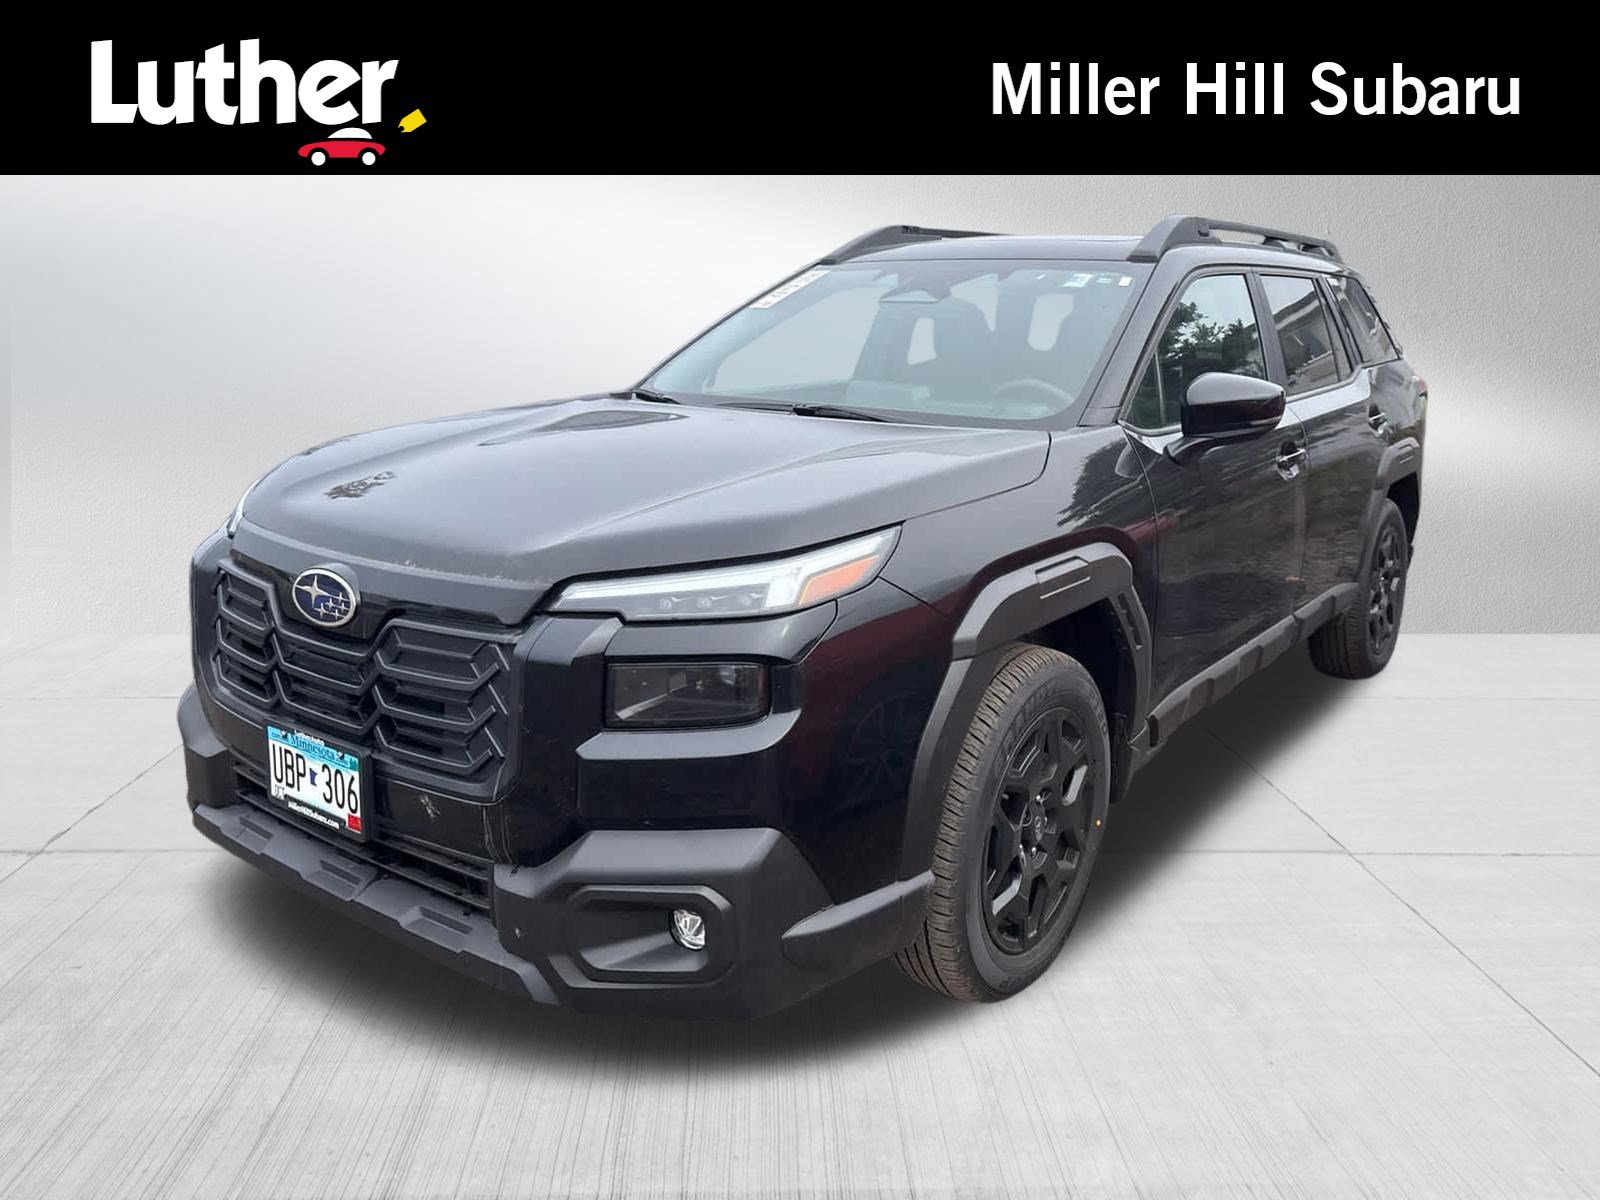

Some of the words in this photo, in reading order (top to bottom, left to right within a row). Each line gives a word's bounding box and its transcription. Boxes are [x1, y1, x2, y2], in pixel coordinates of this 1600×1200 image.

[288, 734, 336, 760] Minnesota
[272, 743, 306, 792] UBP
[321, 763, 359, 814] 306
